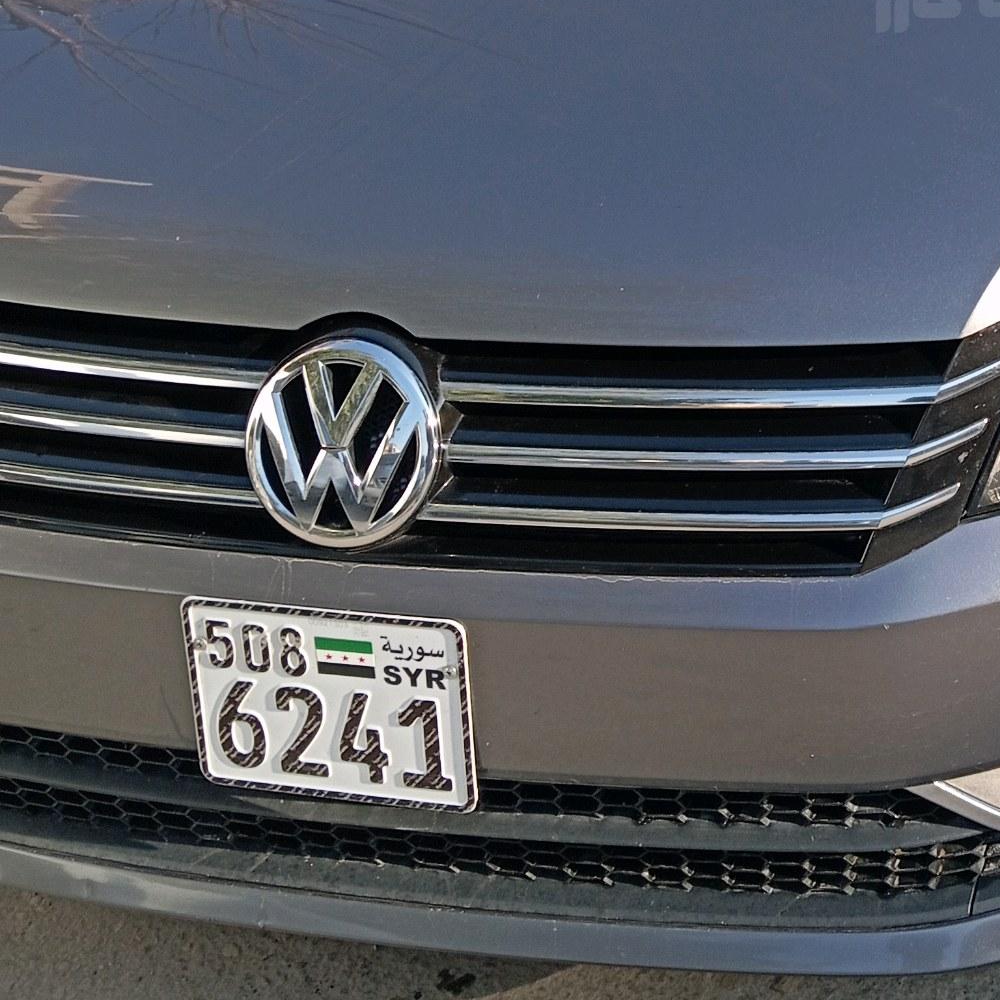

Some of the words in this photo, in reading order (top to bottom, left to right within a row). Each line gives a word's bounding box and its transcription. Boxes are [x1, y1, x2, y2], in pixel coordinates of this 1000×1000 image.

[248, 347, 432, 541] VW
[205, 619, 307, 677] 508
[379, 635, 445, 662] سورية
[383, 665, 447, 690] SYR
[218, 680, 453, 792] 6241
